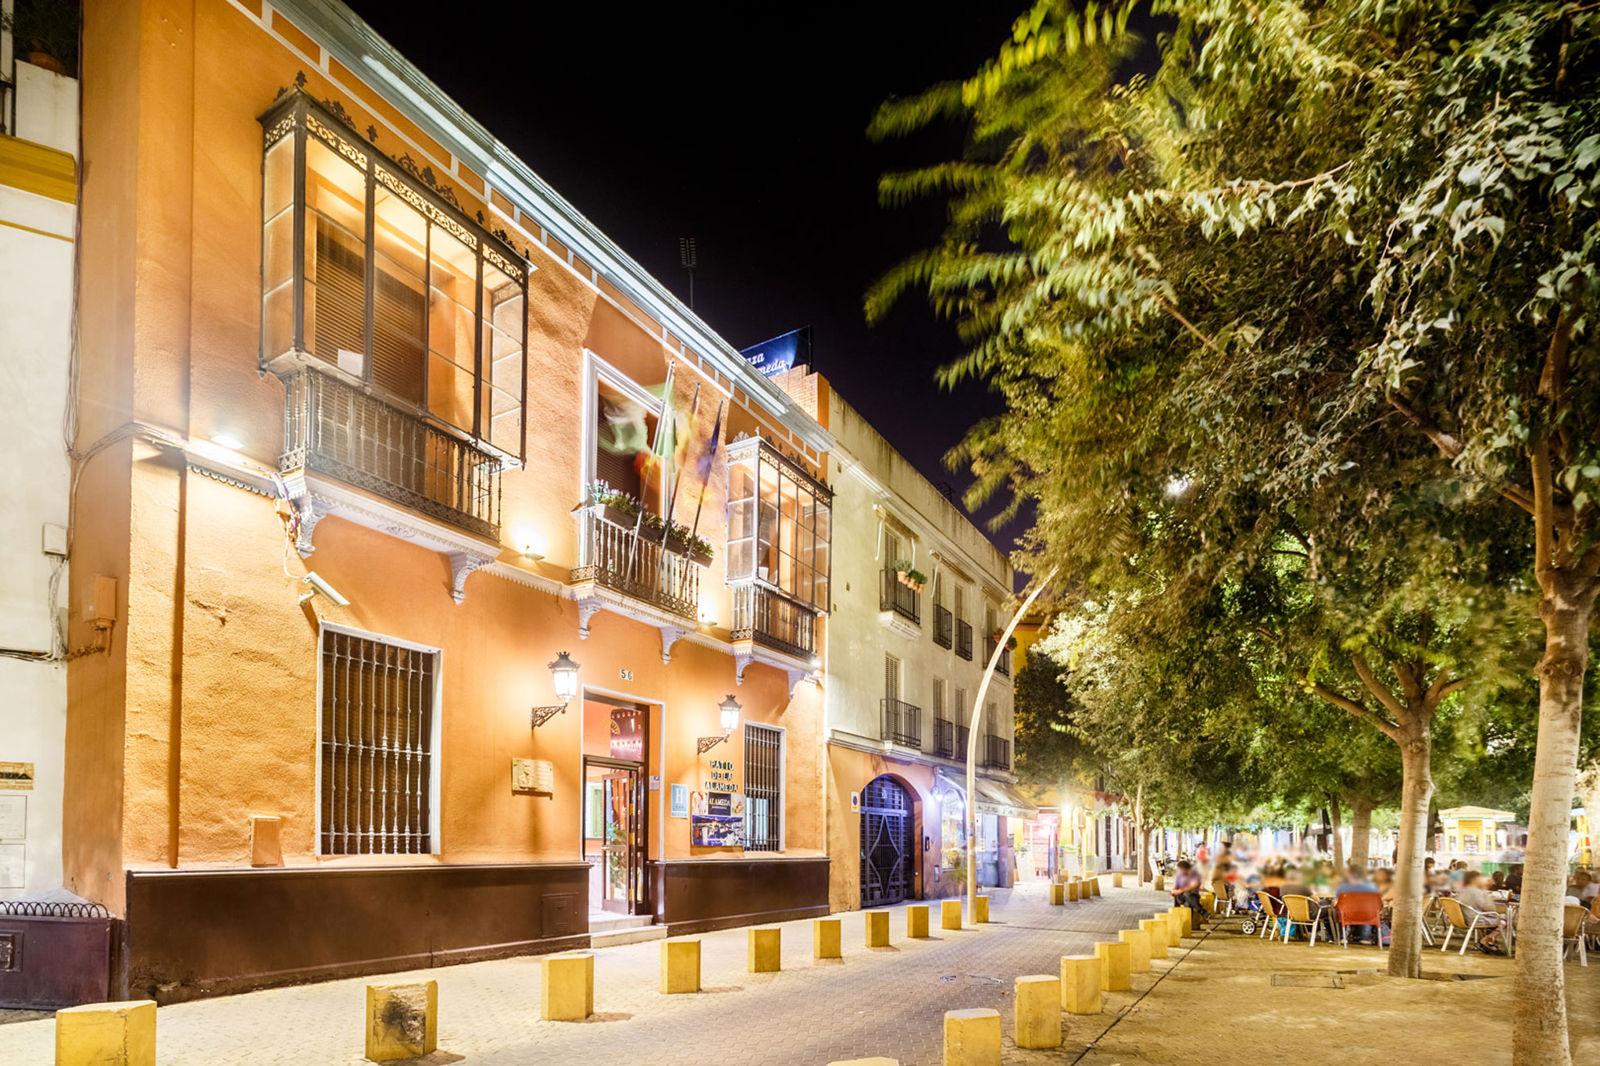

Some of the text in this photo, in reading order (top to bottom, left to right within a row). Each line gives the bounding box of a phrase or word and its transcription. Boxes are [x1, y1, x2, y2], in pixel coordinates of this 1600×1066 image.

[710, 760, 734, 771] PATIO
[711, 771, 732, 781] DE LA
[705, 781, 738, 792] ALAMEDA
[676, 788, 684, 804] H
